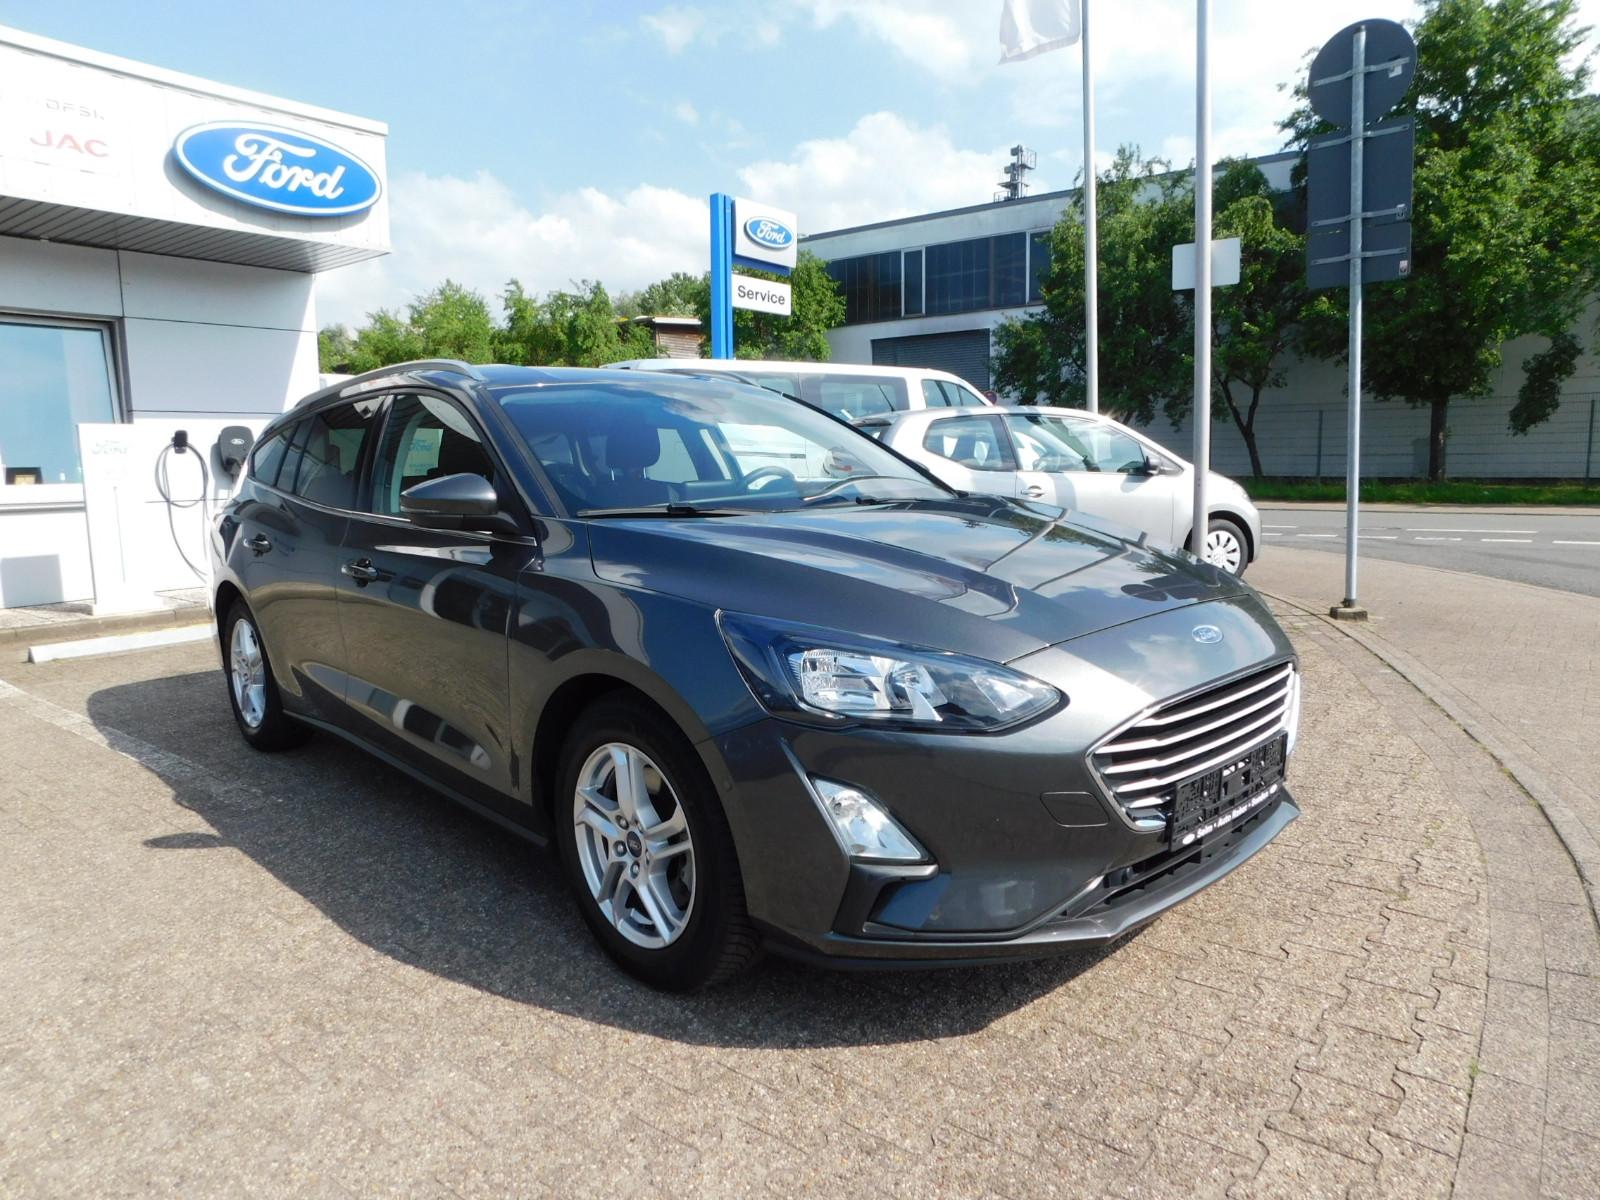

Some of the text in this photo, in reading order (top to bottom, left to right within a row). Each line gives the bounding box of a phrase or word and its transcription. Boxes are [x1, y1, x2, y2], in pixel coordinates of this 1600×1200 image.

[29, 129, 110, 158] JAC
[223, 132, 346, 200] Ford
[756, 219, 786, 244] Ford
[737, 284, 786, 306] Service
